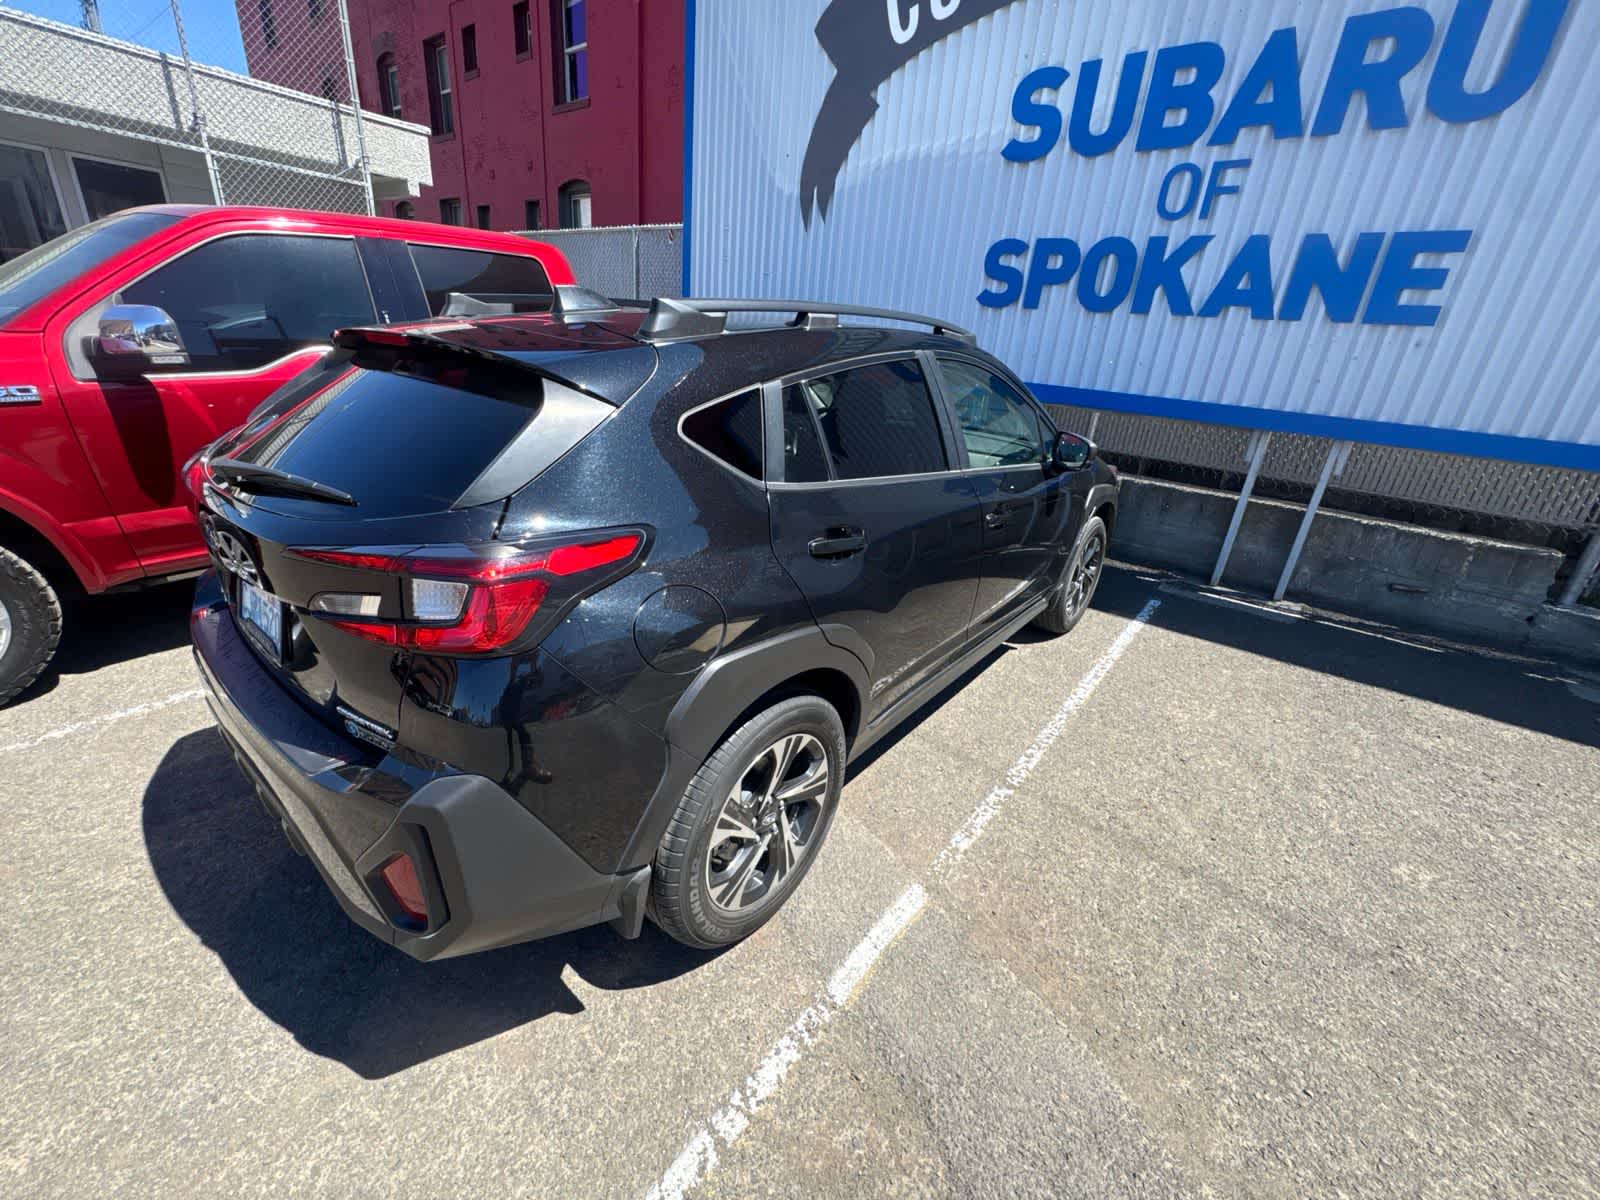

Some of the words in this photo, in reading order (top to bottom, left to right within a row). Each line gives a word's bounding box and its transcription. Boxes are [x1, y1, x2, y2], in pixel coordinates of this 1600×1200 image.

[1000, 0, 1569, 163] SUBARU
[1156, 158, 1252, 222] OF
[976, 230, 1472, 327] SPOKANE
